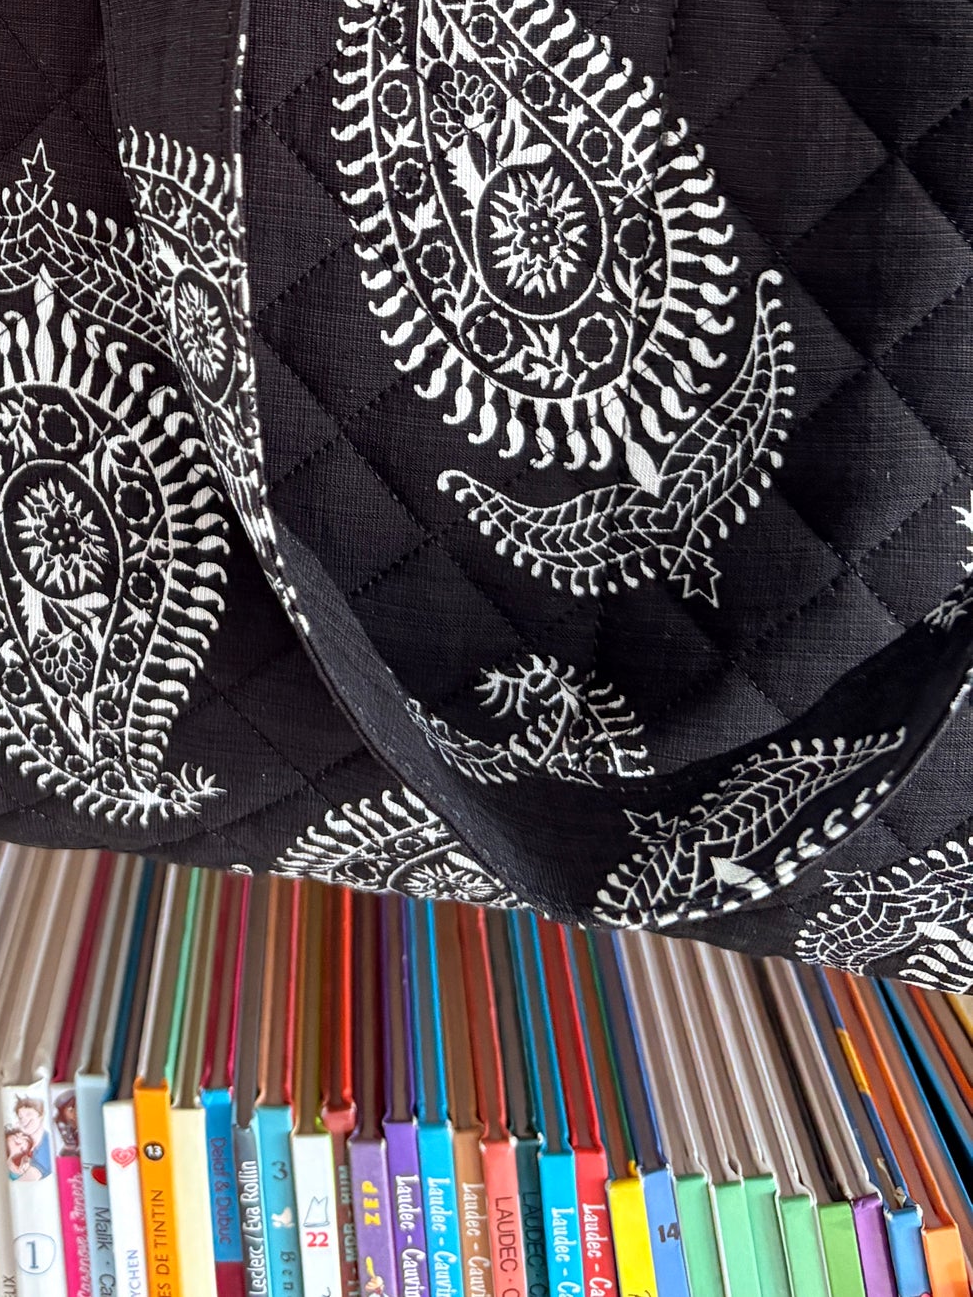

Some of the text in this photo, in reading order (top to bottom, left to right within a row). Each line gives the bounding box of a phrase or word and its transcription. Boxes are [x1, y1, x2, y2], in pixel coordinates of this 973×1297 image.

[145, 1144, 162, 1157] 13
[238, 1159, 260, 1203] Rollin
[361, 1180, 382, 1226] ZEP
[396, 1175, 421, 1232] Laudec
[427, 1177, 453, 1232] Laudec
[93, 1206, 113, 1251] Malik
[151, 1189, 167, 1249] TINTIN
[242, 1205, 263, 1234] Eva
[462, 1182, 487, 1237] Laudec
[522, 1191, 544, 1268] LAUDEC
[582, 1203, 609, 1259] Laudec
[657, 1222, 680, 1243] 14
[26, 1240, 39, 1269] 1
[306, 1231, 330, 1248] 22
[495, 1196, 519, 1273] LAUDEC
[551, 1207, 577, 1263] Laudec
[155, 1253, 170, 1275] DE
[249, 1245, 268, 1297] Leclerc
